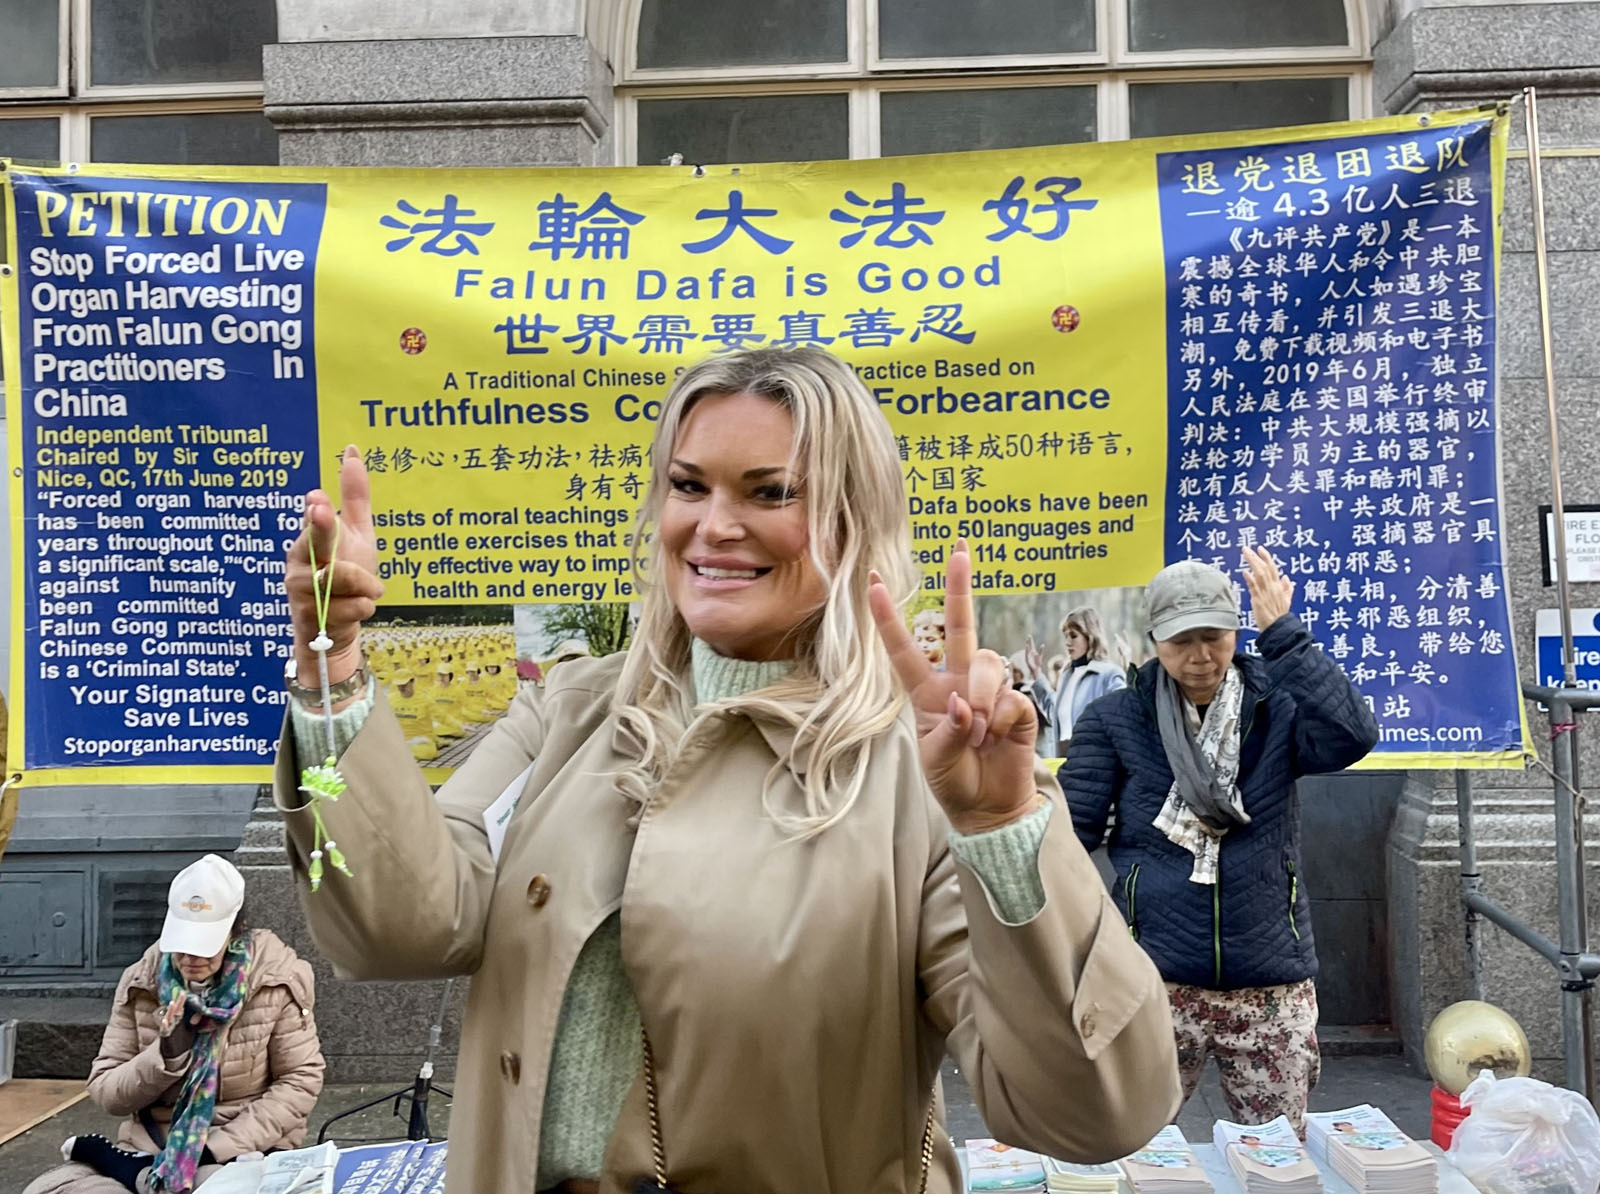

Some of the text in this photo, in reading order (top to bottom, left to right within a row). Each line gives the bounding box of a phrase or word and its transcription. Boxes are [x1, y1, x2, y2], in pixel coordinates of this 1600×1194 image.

[1181, 135, 1469, 195] 退党退团退队
[34, 189, 292, 238] PETITION
[379, 175, 1099, 261] 法輪大法好
[1228, 214, 1481, 252] 《九评共产党》是一本
[30, 243, 304, 282] Stop Forced Live
[1179, 244, 1482, 281] 震撼全球华人和令中共胆
[454, 255, 1001, 301] Falun Dafa is Good
[31, 278, 302, 318] Organ Harvesting
[33, 314, 302, 350] From Falun Gong
[494, 303, 977, 356] 世界需要真善忍
[34, 349, 304, 382] Practitioners In
[443, 373, 459, 390] A
[465, 370, 575, 390] Traditional
[583, 368, 666, 387] Chinese
[843, 361, 927, 380] ractice
[934, 358, 1001, 378] Based
[1009, 361, 1035, 377] on
[34, 388, 128, 418] China
[360, 398, 590, 427] Truthfulness
[873, 386, 1110, 415] Forbearance
[1180, 379, 1488, 418] 人民法庭在英国举行终审
[36, 424, 268, 447] Independent Tribunal
[37, 448, 305, 470] Chaired by Sir Geoffrey
[37, 469, 288, 490] Nice, QC, 17th June 2019
[564, 465, 987, 501] 身有奇 个国家
[38, 490, 306, 513] “Forced organ harvesting
[371, 508, 425, 527] sists
[432, 509, 453, 526] of
[459, 508, 518, 525] moral
[524, 505, 629, 528] teachings
[909, 496, 957, 515] Dafa
[966, 494, 1031, 514] books
[1040, 493, 1090, 512] have
[1098, 491, 1148, 511] been
[37, 511, 304, 531] has been committed for
[393, 532, 459, 555] gentle
[465, 532, 568, 550] exercises
[574, 530, 617, 548] that
[913, 521, 951, 539] into
[987, 519, 1092, 542] languages
[1098, 515, 1135, 534] and
[1564, 520, 1587, 530] IRE
[37, 535, 98, 554] years
[107, 533, 213, 554] throughout
[220, 533, 275, 552] China
[38, 560, 51, 574] a
[58, 556, 165, 577] significant
[376, 558, 422, 579] ghly
[427, 556, 514, 575] effective
[519, 557, 560, 577] way
[565, 555, 586, 572] to
[975, 543, 1007, 562] 114
[1014, 542, 1108, 562] countries
[39, 577, 119, 598] against
[150, 577, 236, 599] humanity
[413, 581, 479, 599] health
[486, 580, 526, 598] and
[532, 580, 607, 601] energy
[40, 598, 292, 620] been committed again
[40, 618, 295, 640] Falun Gong practitioners
[40, 640, 128, 658] Chinese
[141, 639, 253, 658] Communist
[40, 662, 59, 680] is
[66, 665, 79, 679] a
[86, 660, 180, 679] ‘Criminal
[1338, 660, 1451, 687] 和平安。
[70, 685, 291, 709] Your Signature Can
[124, 707, 250, 728] Save Lives
[1378, 723, 1483, 743] imes.com
